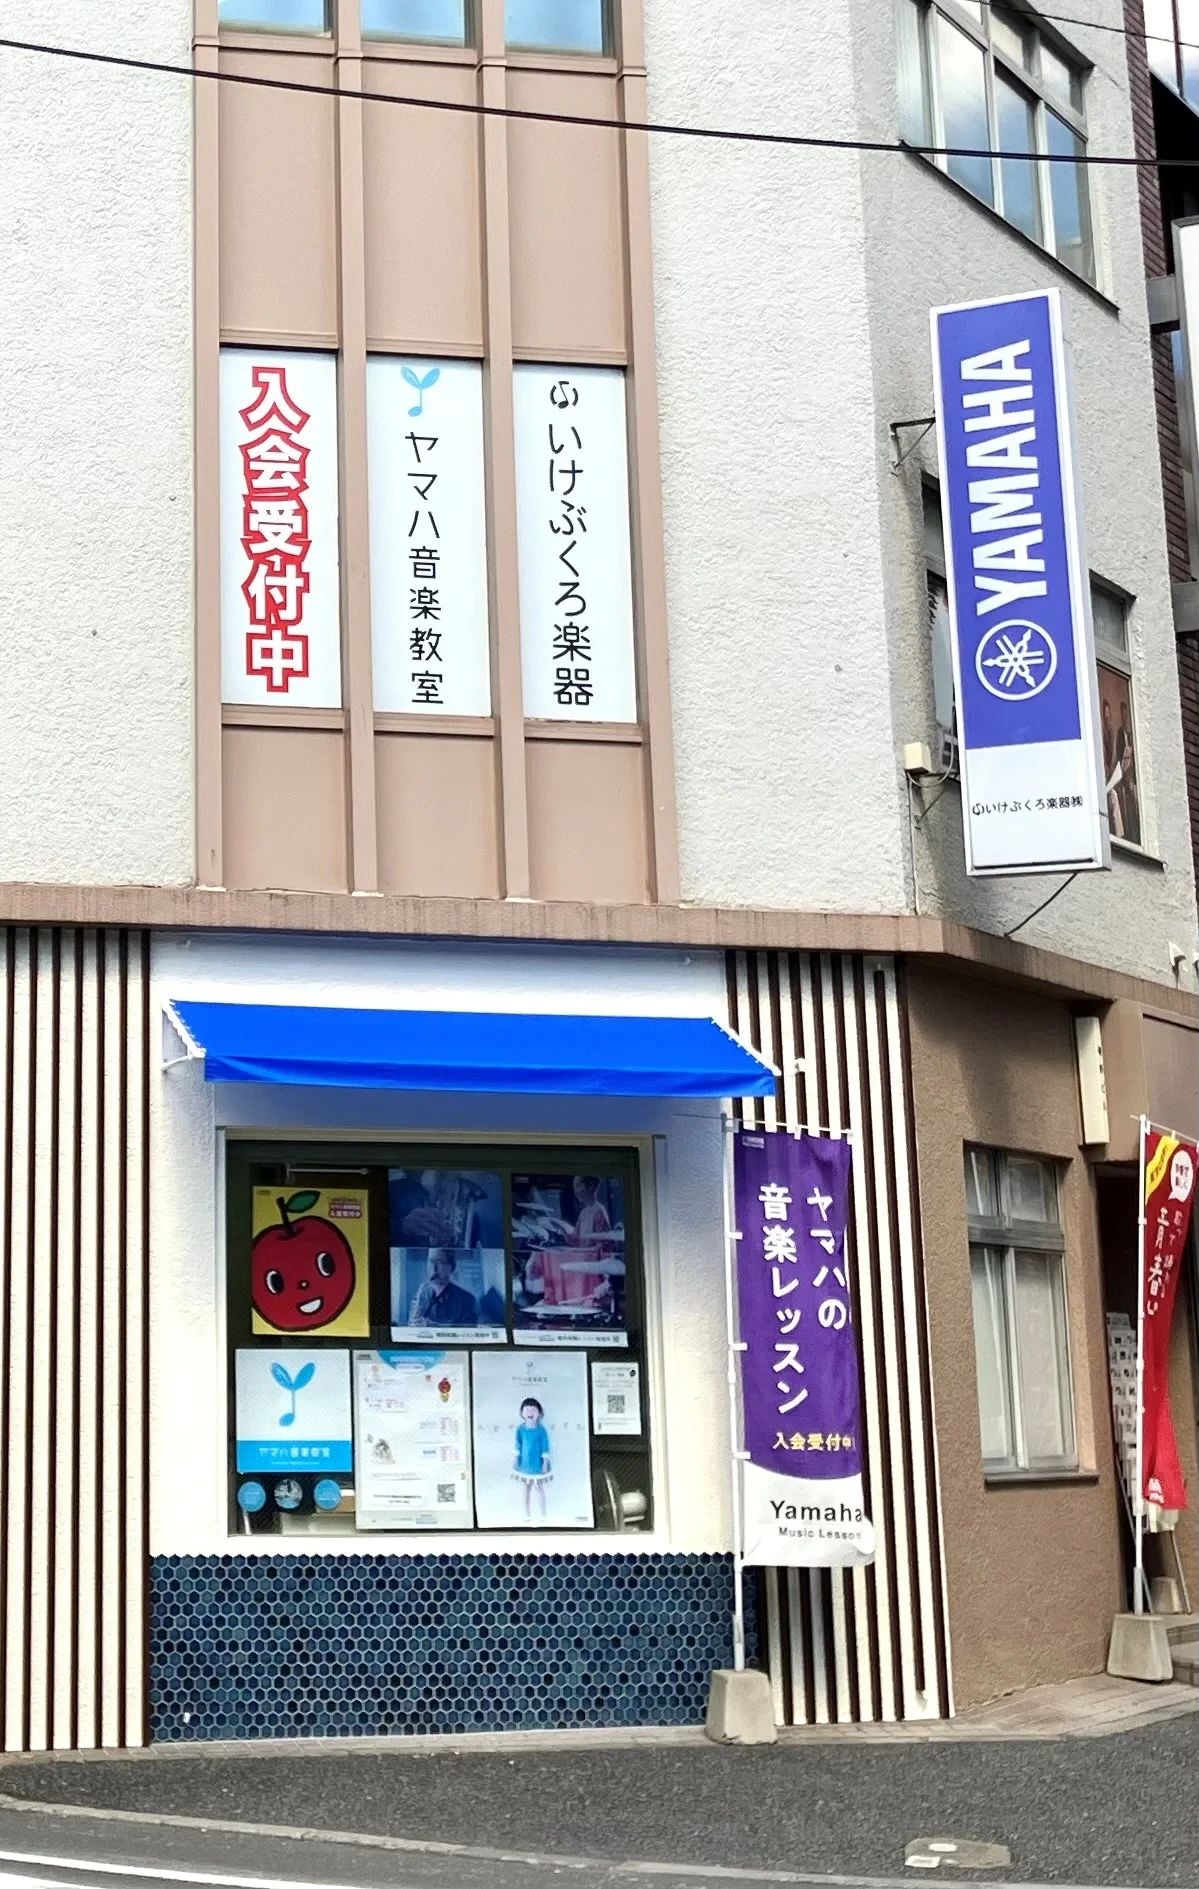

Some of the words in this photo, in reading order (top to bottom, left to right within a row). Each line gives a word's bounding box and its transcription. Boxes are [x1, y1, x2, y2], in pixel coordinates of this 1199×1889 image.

[238, 366, 311, 692] 入会受付中
[404, 431, 444, 704] ヤマハ音楽教室
[548, 423, 594, 706] いけぶくろ楽器
[960, 338, 1048, 616] YAMAHA
[758, 1183, 808, 1414] 音楽レッスン
[806, 1187, 846, 1330] ヤマハの
[770, 1500, 862, 1522] Yamaha
[778, 1526, 815, 1538] Music
